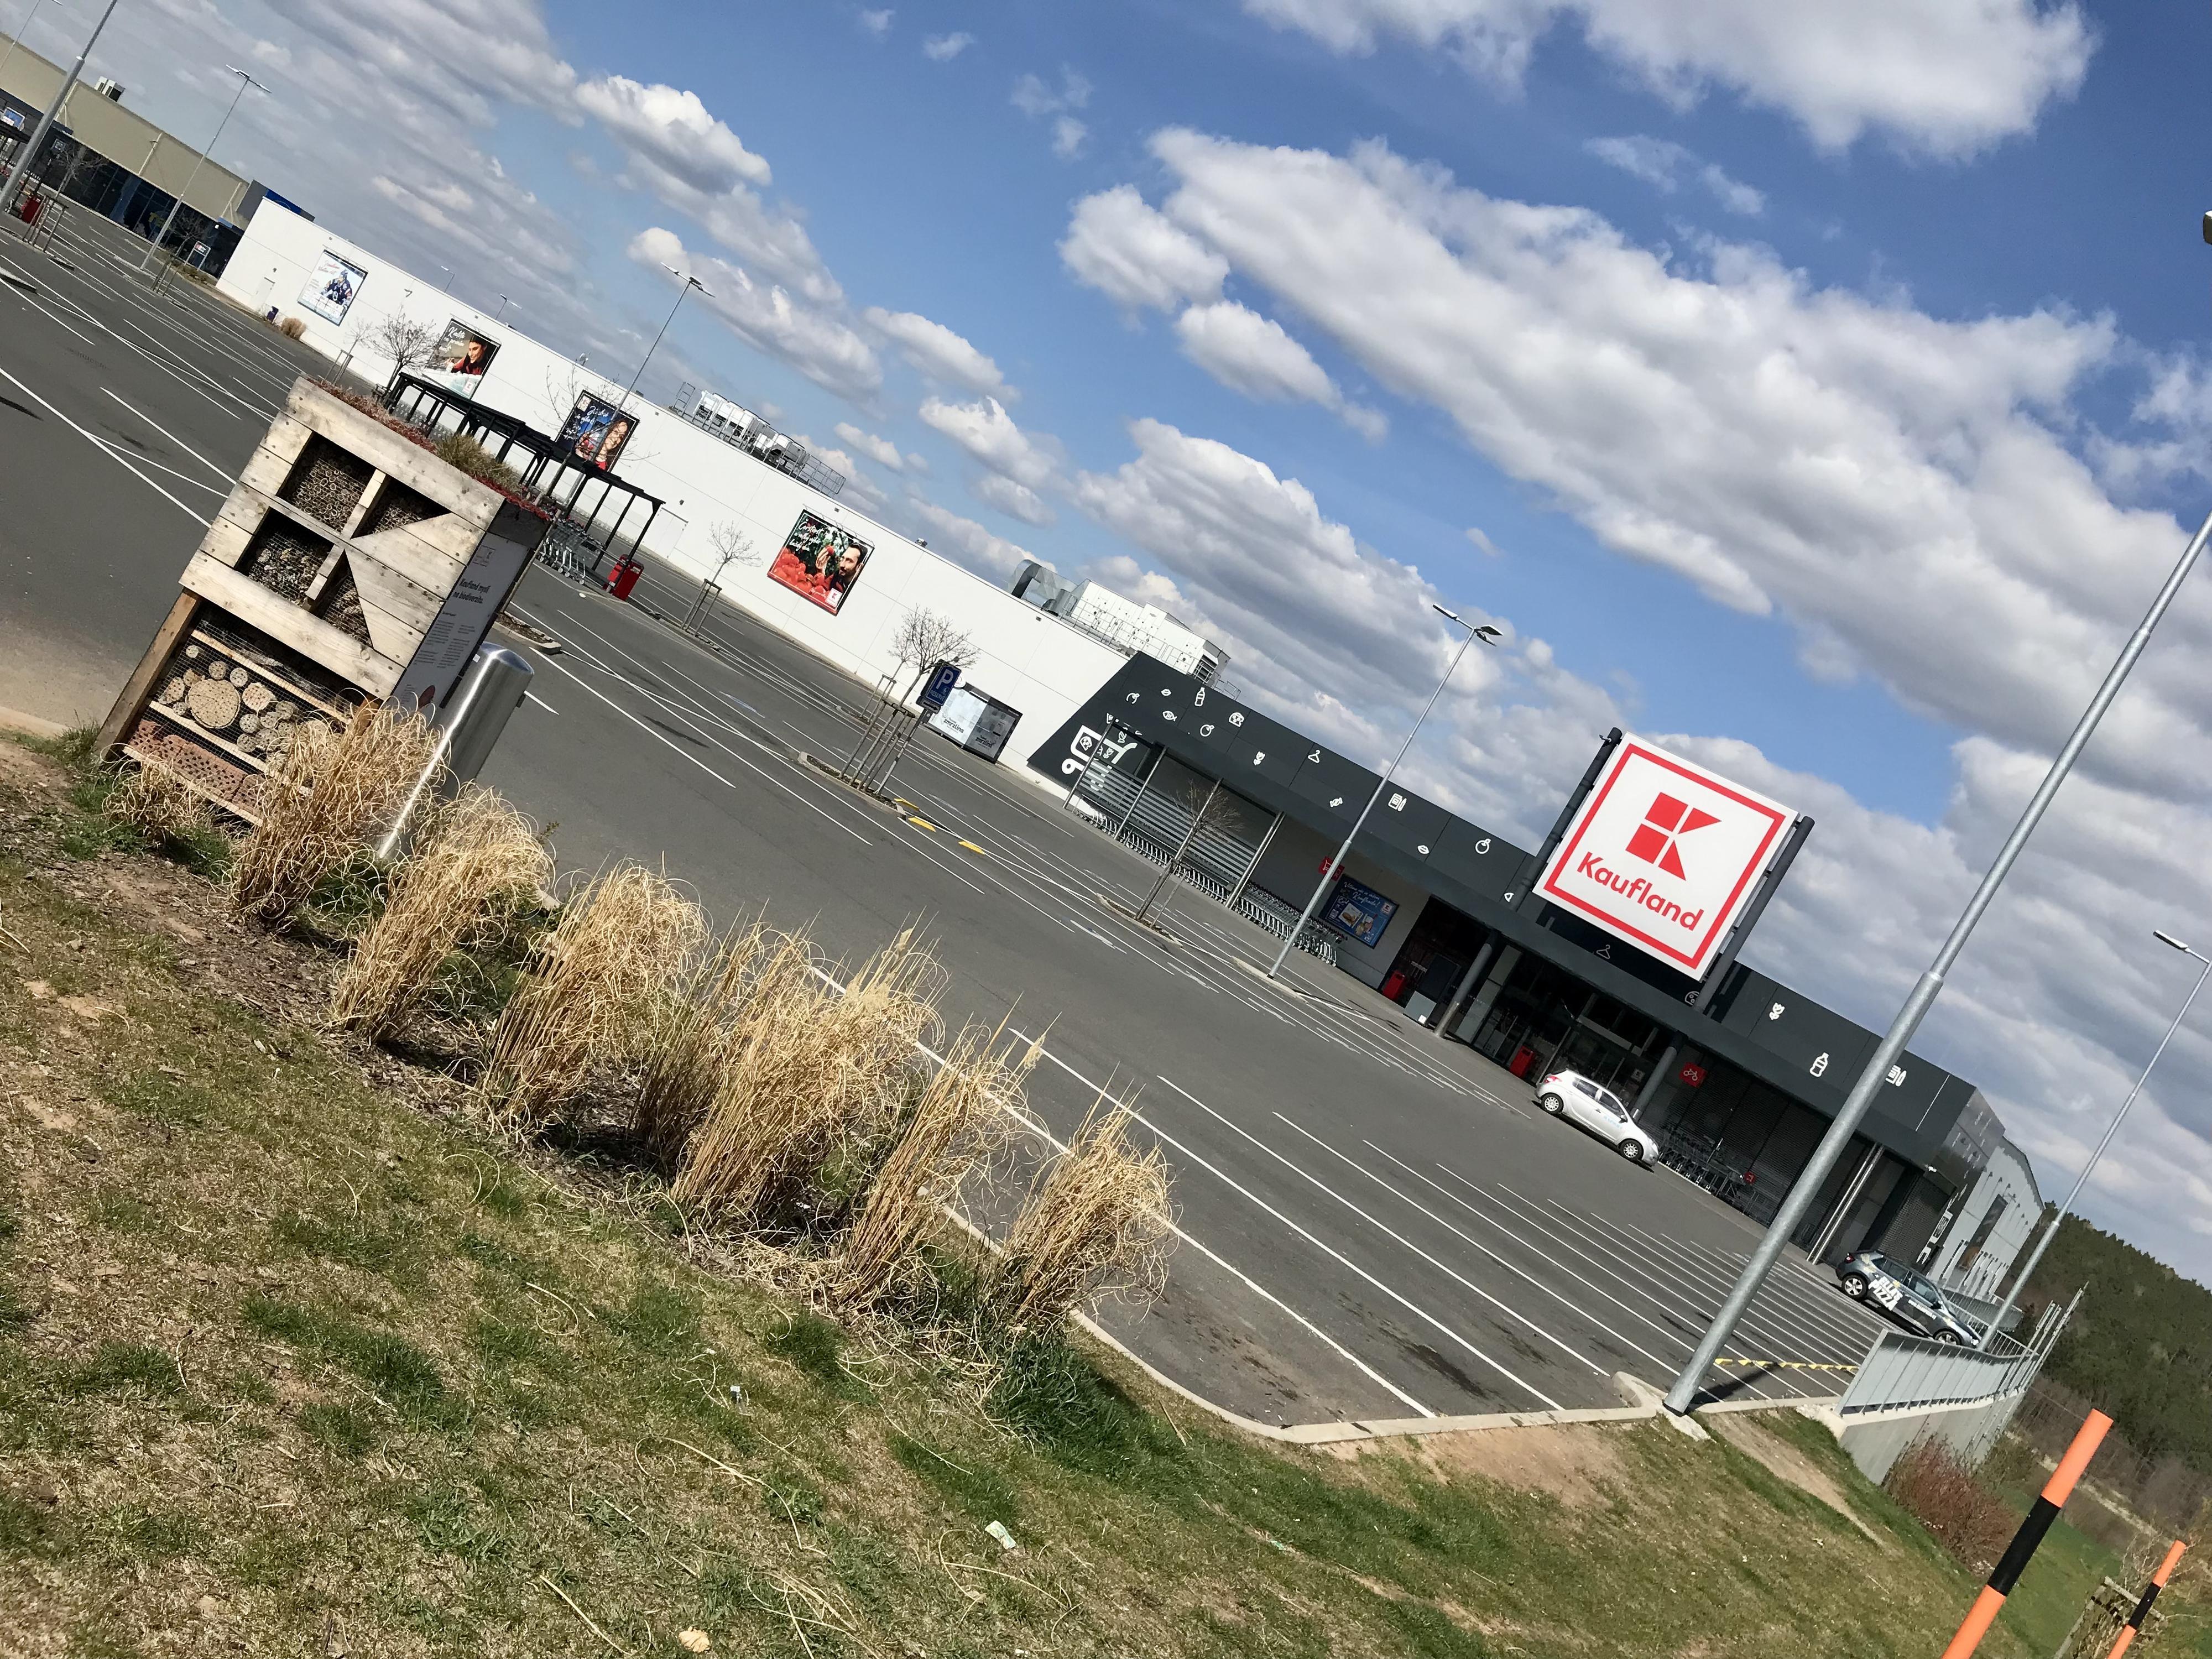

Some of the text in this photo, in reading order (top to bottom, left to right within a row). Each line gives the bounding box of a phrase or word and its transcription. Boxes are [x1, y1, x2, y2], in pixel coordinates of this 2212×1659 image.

[935, 669, 953, 689] P
[943, 718, 964, 733] zmrzlina
[1577, 852, 1704, 931] Kaufland
[1869, 1279, 1898, 1311] PIZZA
